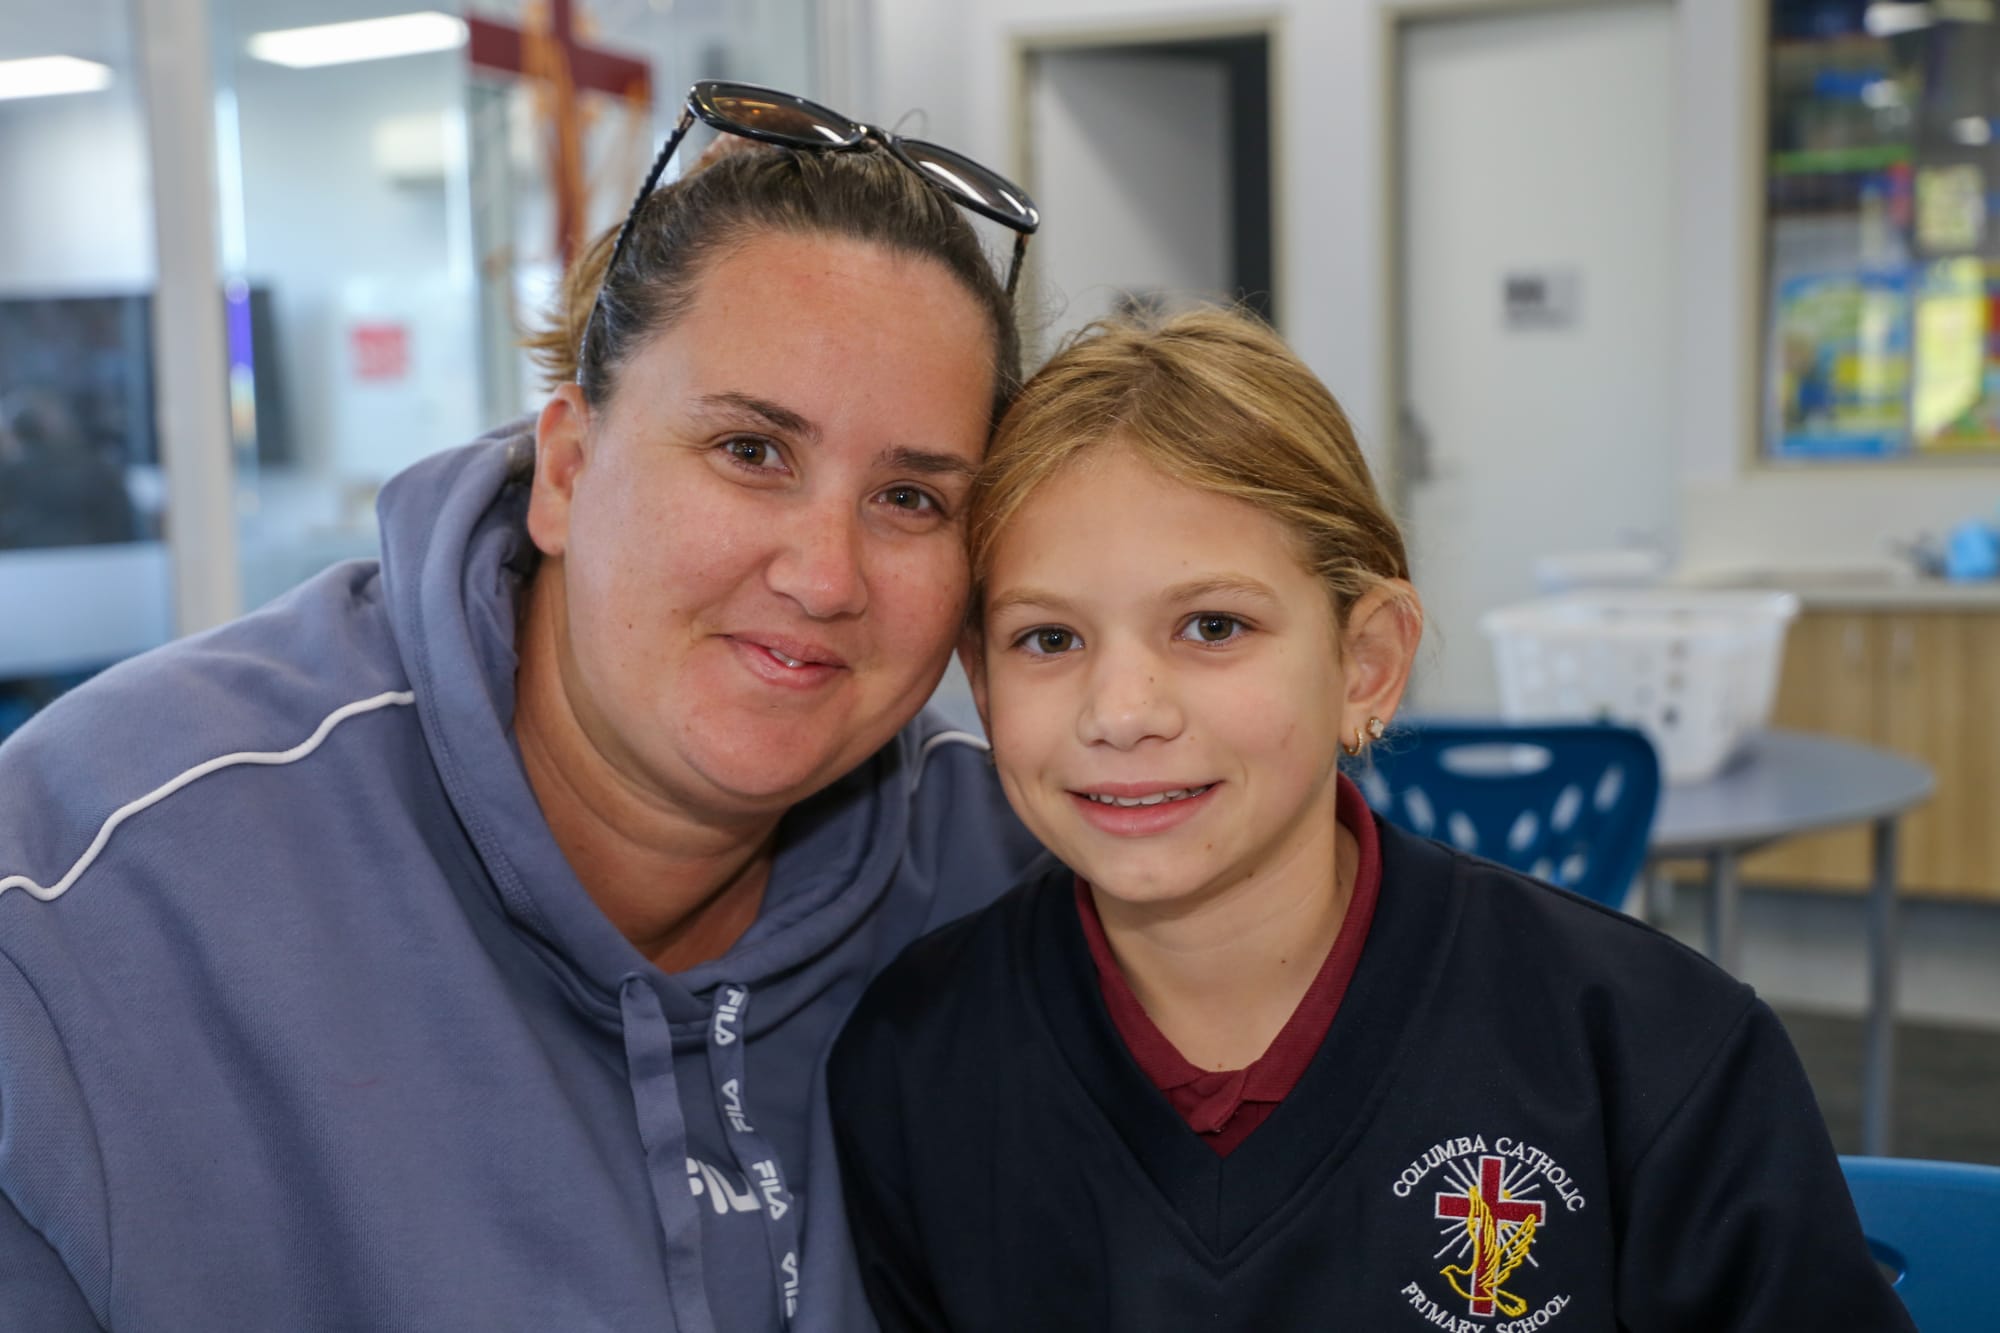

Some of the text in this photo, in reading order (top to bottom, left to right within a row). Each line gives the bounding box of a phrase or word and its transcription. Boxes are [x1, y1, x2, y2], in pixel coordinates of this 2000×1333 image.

[714, 988, 745, 1046] FILA
[722, 1078, 754, 1133] FILA
[752, 1159, 789, 1221] FILA
[1393, 1134, 1585, 1212] COLUMBA CATHOLIC
[781, 1251, 800, 1318] FILA
[1401, 1281, 1571, 1333] PRIMARY SCHOOL
